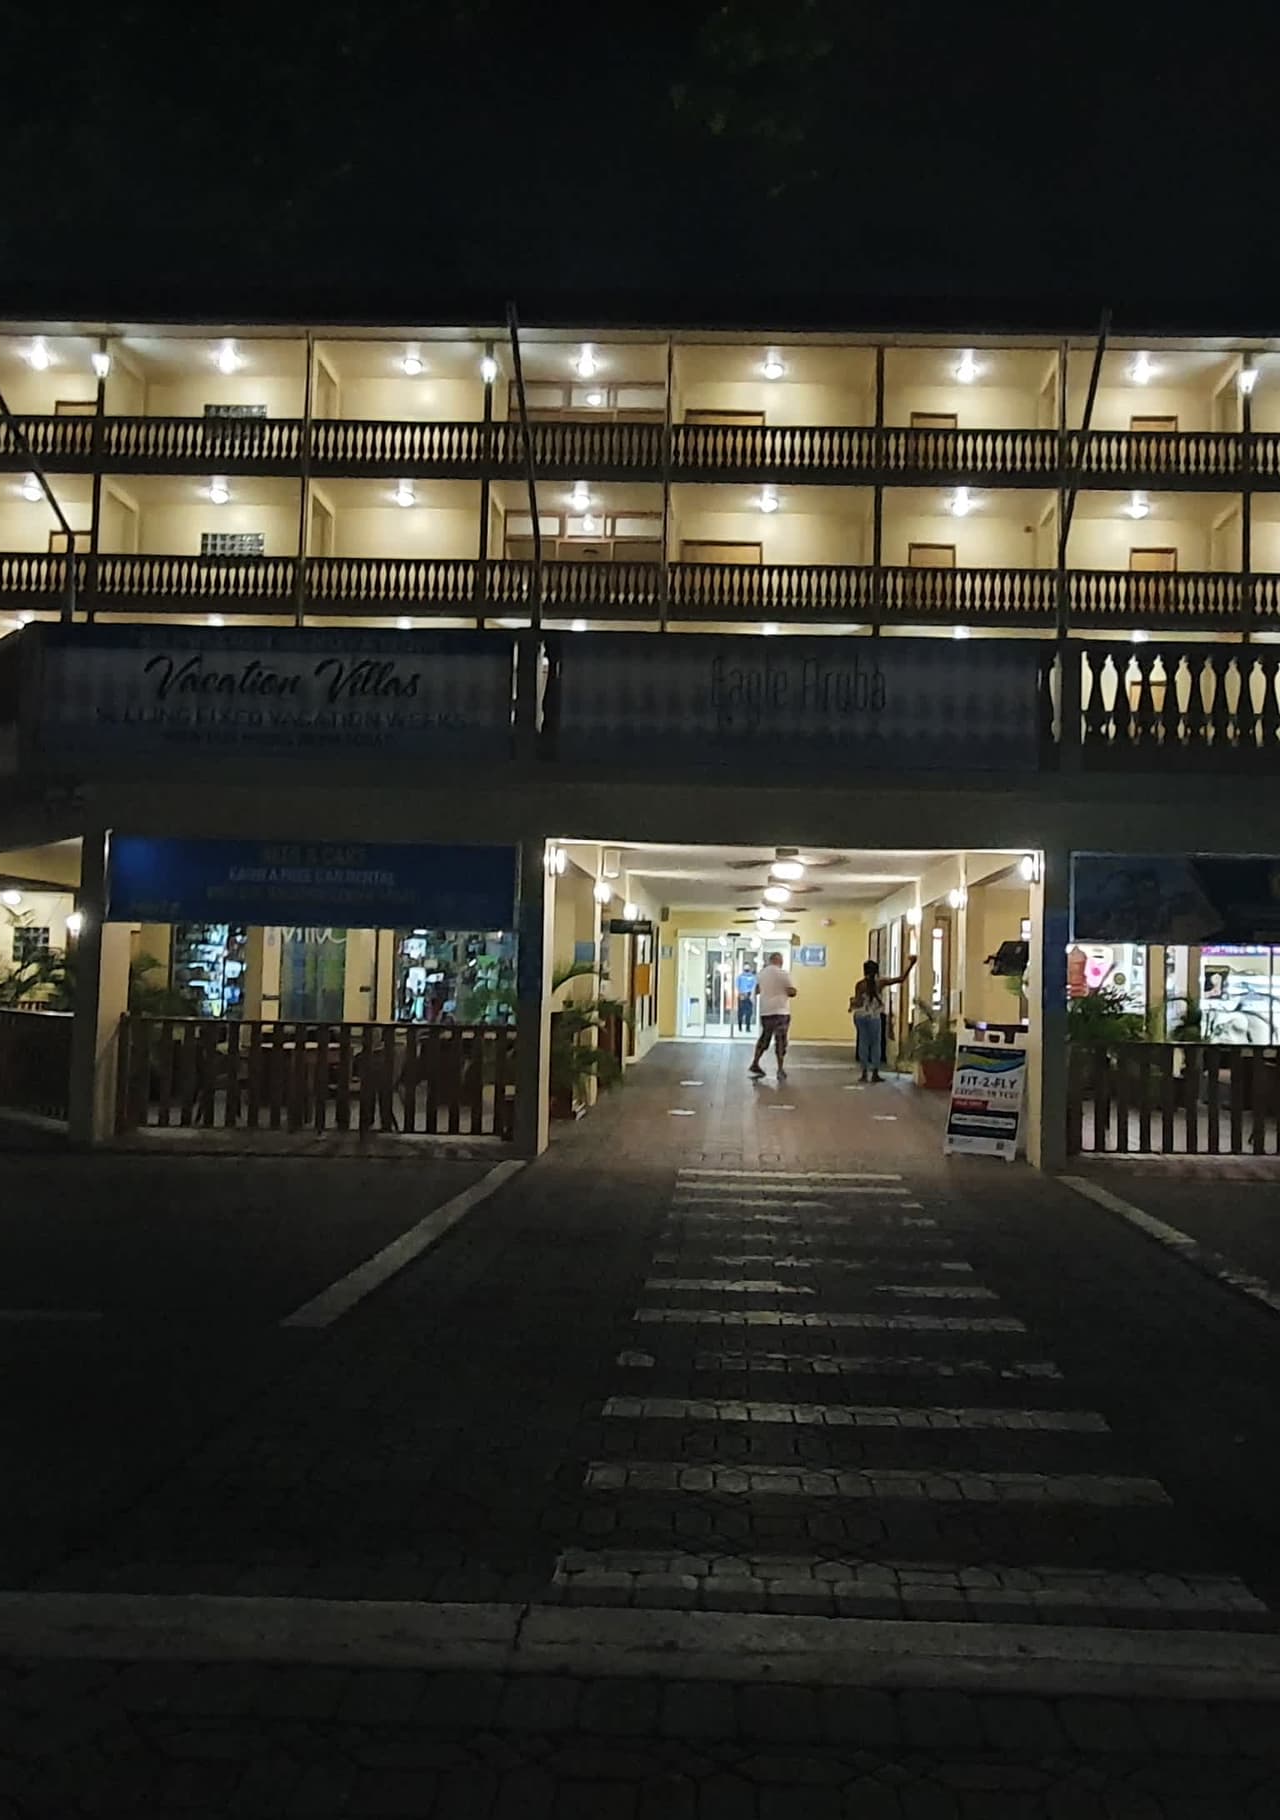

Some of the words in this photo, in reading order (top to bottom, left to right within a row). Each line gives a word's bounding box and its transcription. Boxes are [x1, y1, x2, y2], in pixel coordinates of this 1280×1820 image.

[143, 653, 301, 701] Vacation
[313, 656, 422, 705] Villas
[803, 653, 888, 713] Aruba
[95, 706, 190, 724] LLING
[960, 1075, 1017, 1089] FIT-2-FLY
